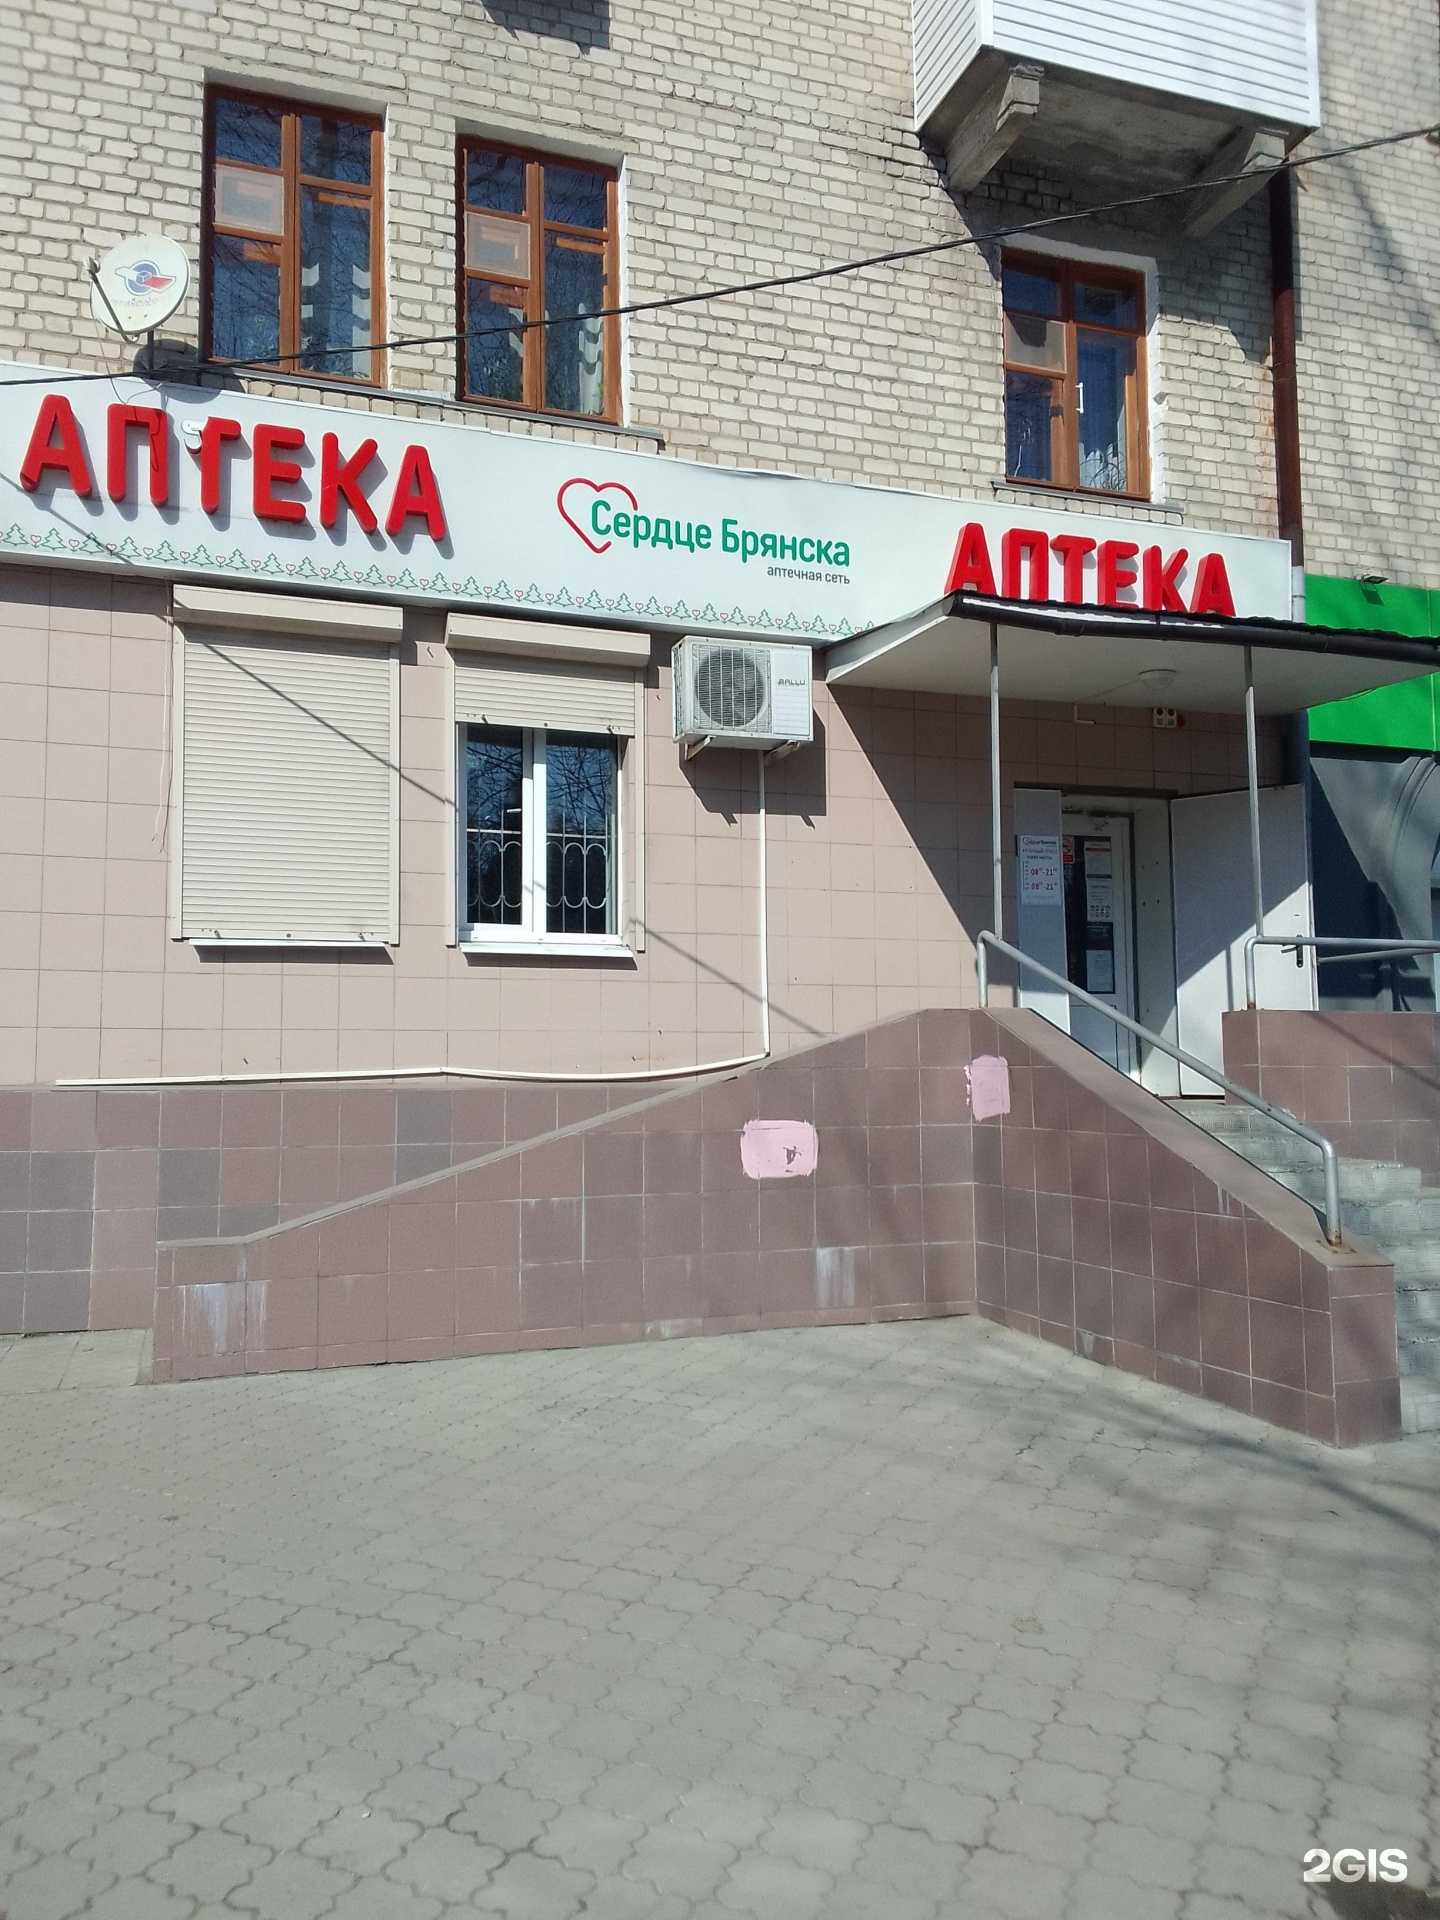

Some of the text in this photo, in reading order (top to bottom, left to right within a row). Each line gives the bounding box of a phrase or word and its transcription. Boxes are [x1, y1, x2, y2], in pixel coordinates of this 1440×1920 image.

[19, 393, 447, 542] АПТЕКА
[591, 499, 851, 568] Сердце Брянска
[766, 564, 851, 585] аптечная сеть
[943, 522, 1237, 617] АПТЕКА
